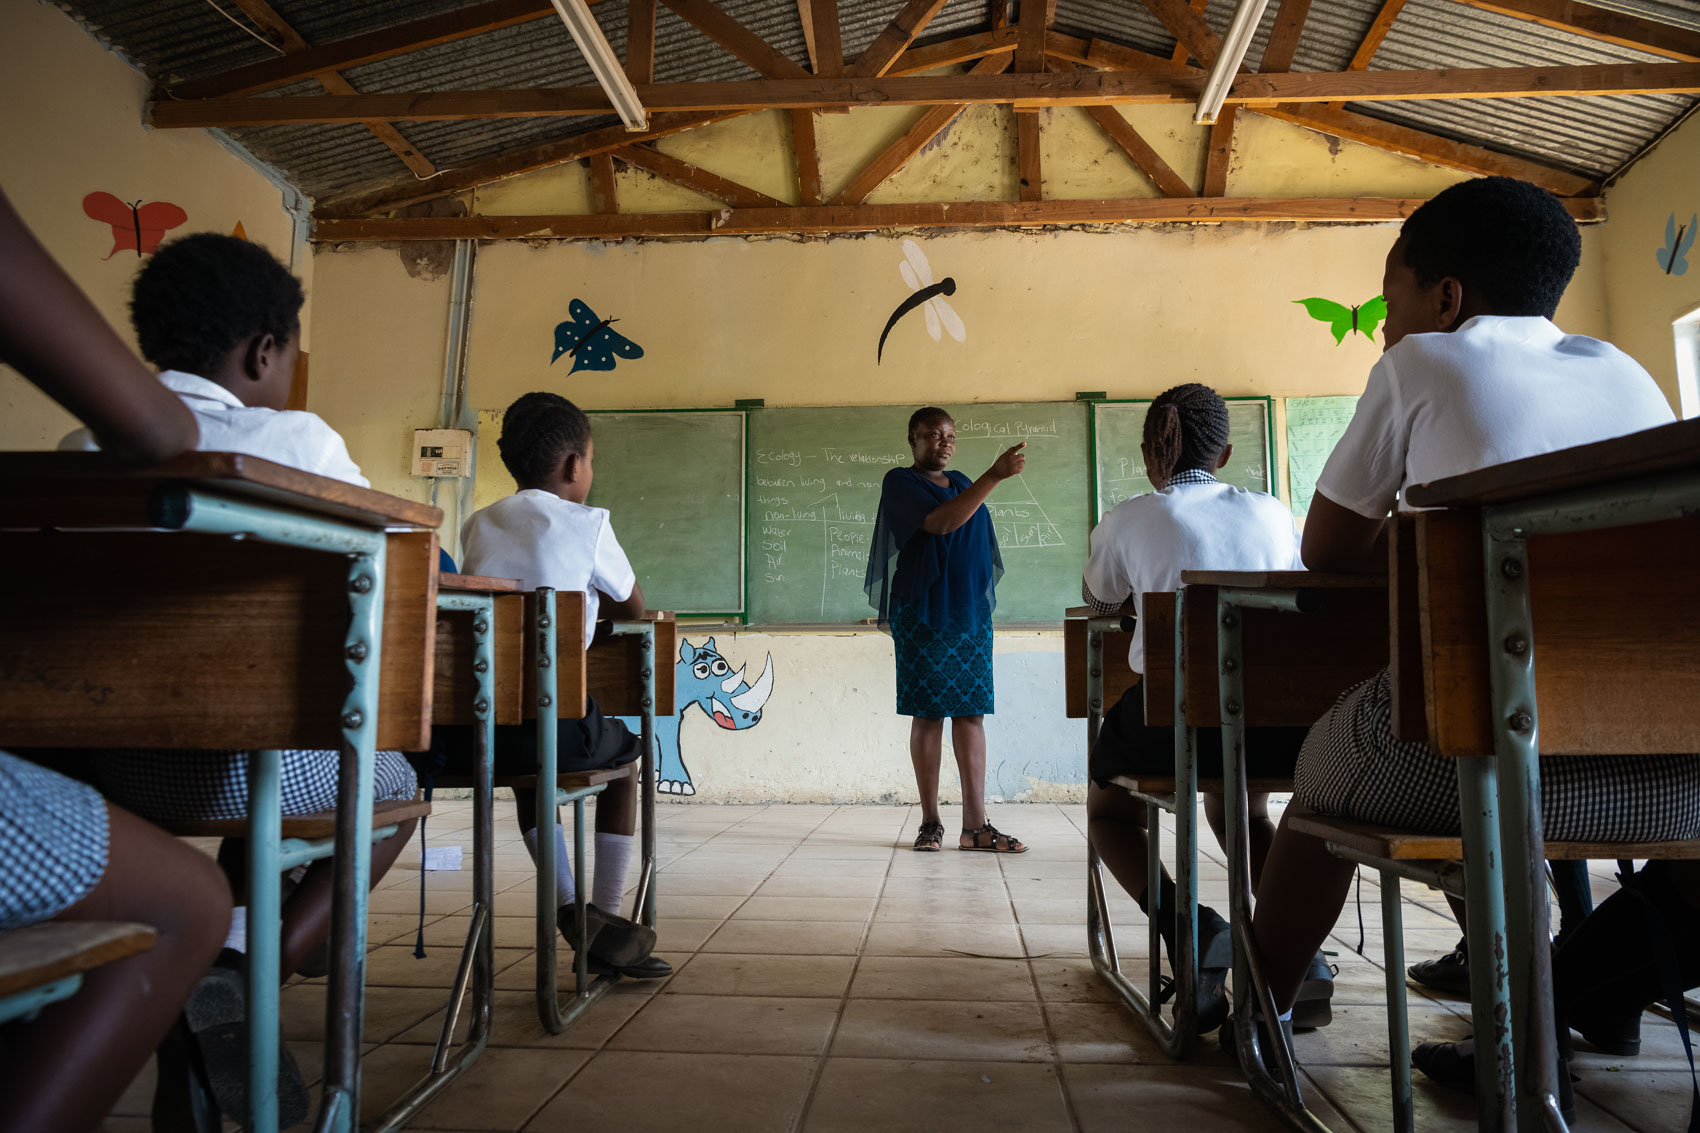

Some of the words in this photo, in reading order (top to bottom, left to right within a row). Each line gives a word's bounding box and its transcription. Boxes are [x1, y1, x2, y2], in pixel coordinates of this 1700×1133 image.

[1014, 419, 1057, 439] Pyramid
[756, 449, 802, 467] Ecology
[821, 447, 845, 464] The
[756, 475, 796, 488] between
[800, 476, 826, 493] living
[836, 477, 852, 488] and
[762, 525, 792, 537] Water
[762, 539, 787, 552] Soil
[765, 553, 783, 570] Air
[764, 572, 786, 583] Sun
